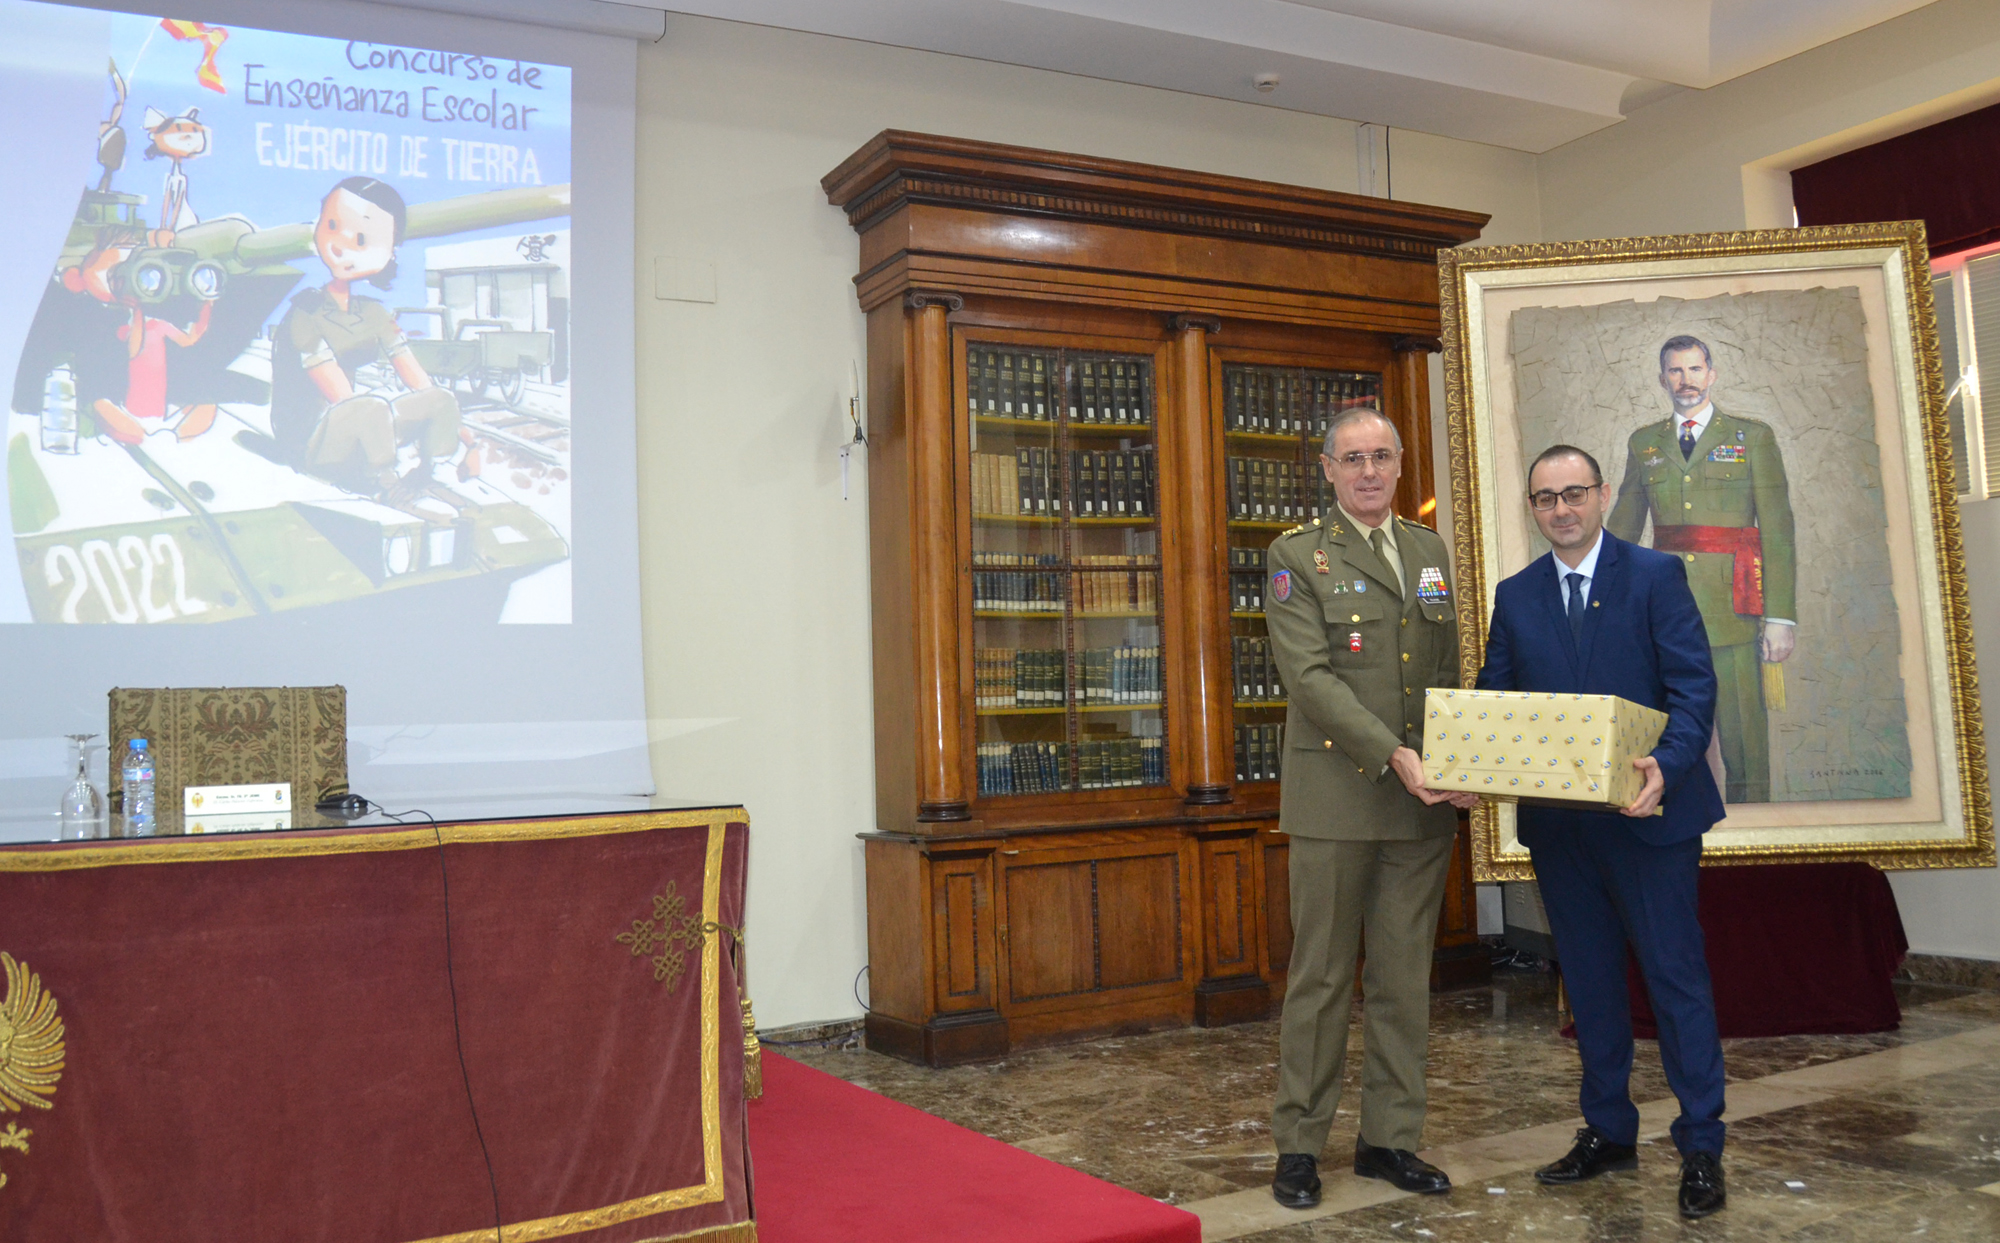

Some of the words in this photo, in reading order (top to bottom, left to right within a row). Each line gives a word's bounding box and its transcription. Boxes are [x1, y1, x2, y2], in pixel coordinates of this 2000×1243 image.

[244, 63, 409, 119] Enseñanza
[422, 86, 539, 131] Escolar
[346, 41, 497, 81] Concurso
[507, 61, 543, 90] de
[255, 119, 388, 175] EJÉRCITO
[400, 136, 428, 178] DE
[442, 138, 543, 185] TIERRA
[44, 533, 209, 624] 2022
